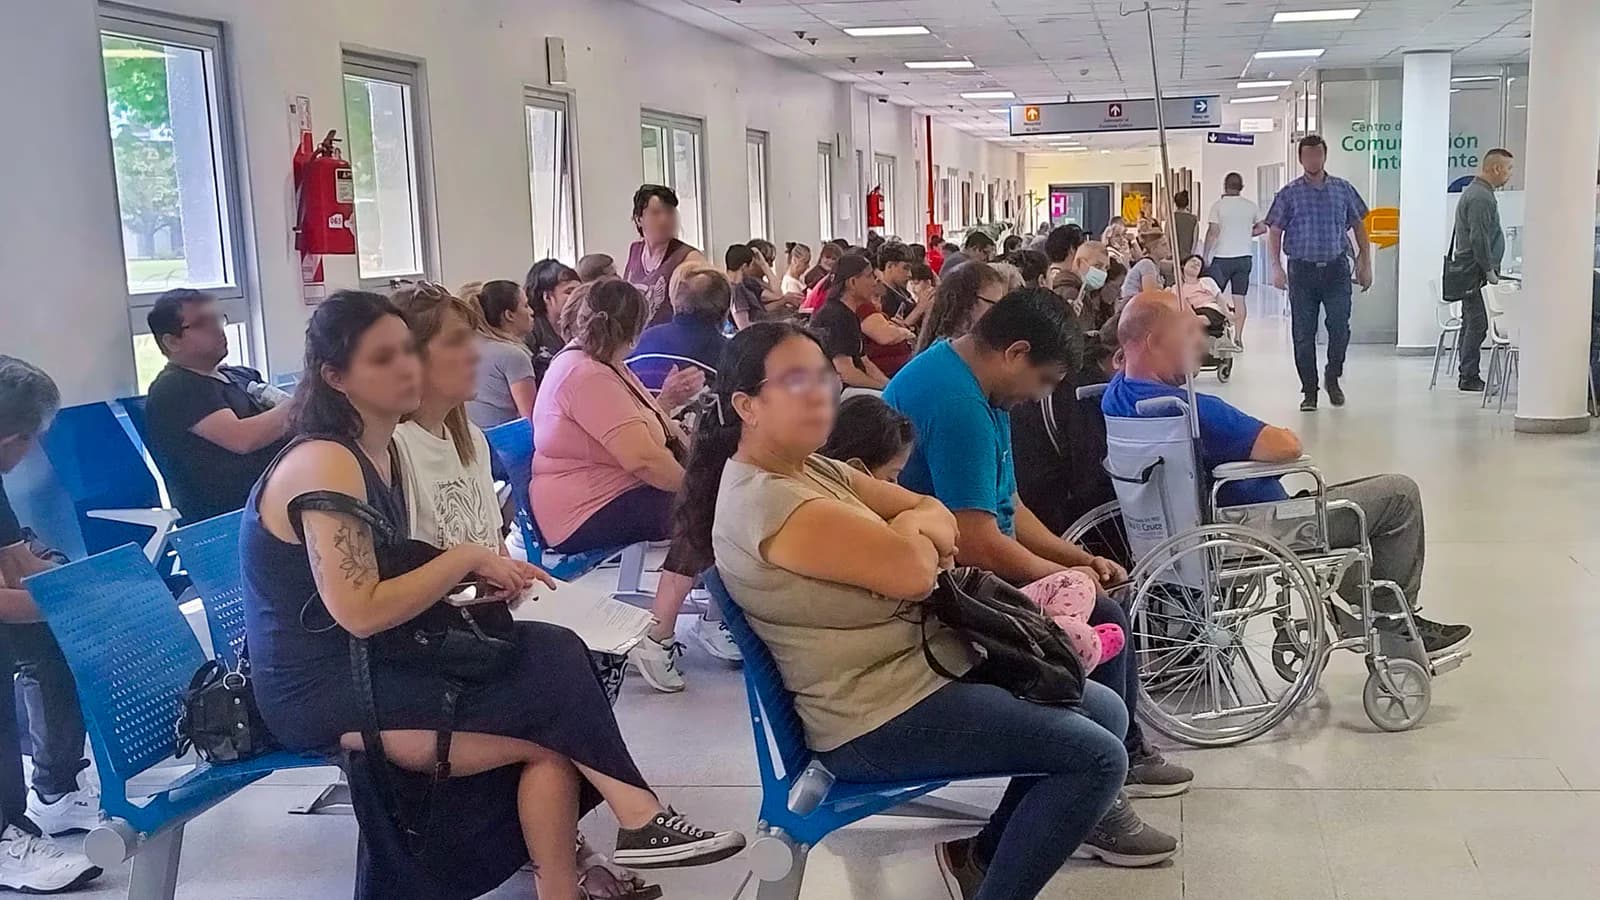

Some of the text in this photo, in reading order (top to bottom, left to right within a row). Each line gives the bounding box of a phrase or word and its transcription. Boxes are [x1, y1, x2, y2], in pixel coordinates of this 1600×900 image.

[1352, 122, 1391, 132] Centro
[1342, 132, 1478, 151] Comuión
[1372, 153, 1478, 169] Intnte
